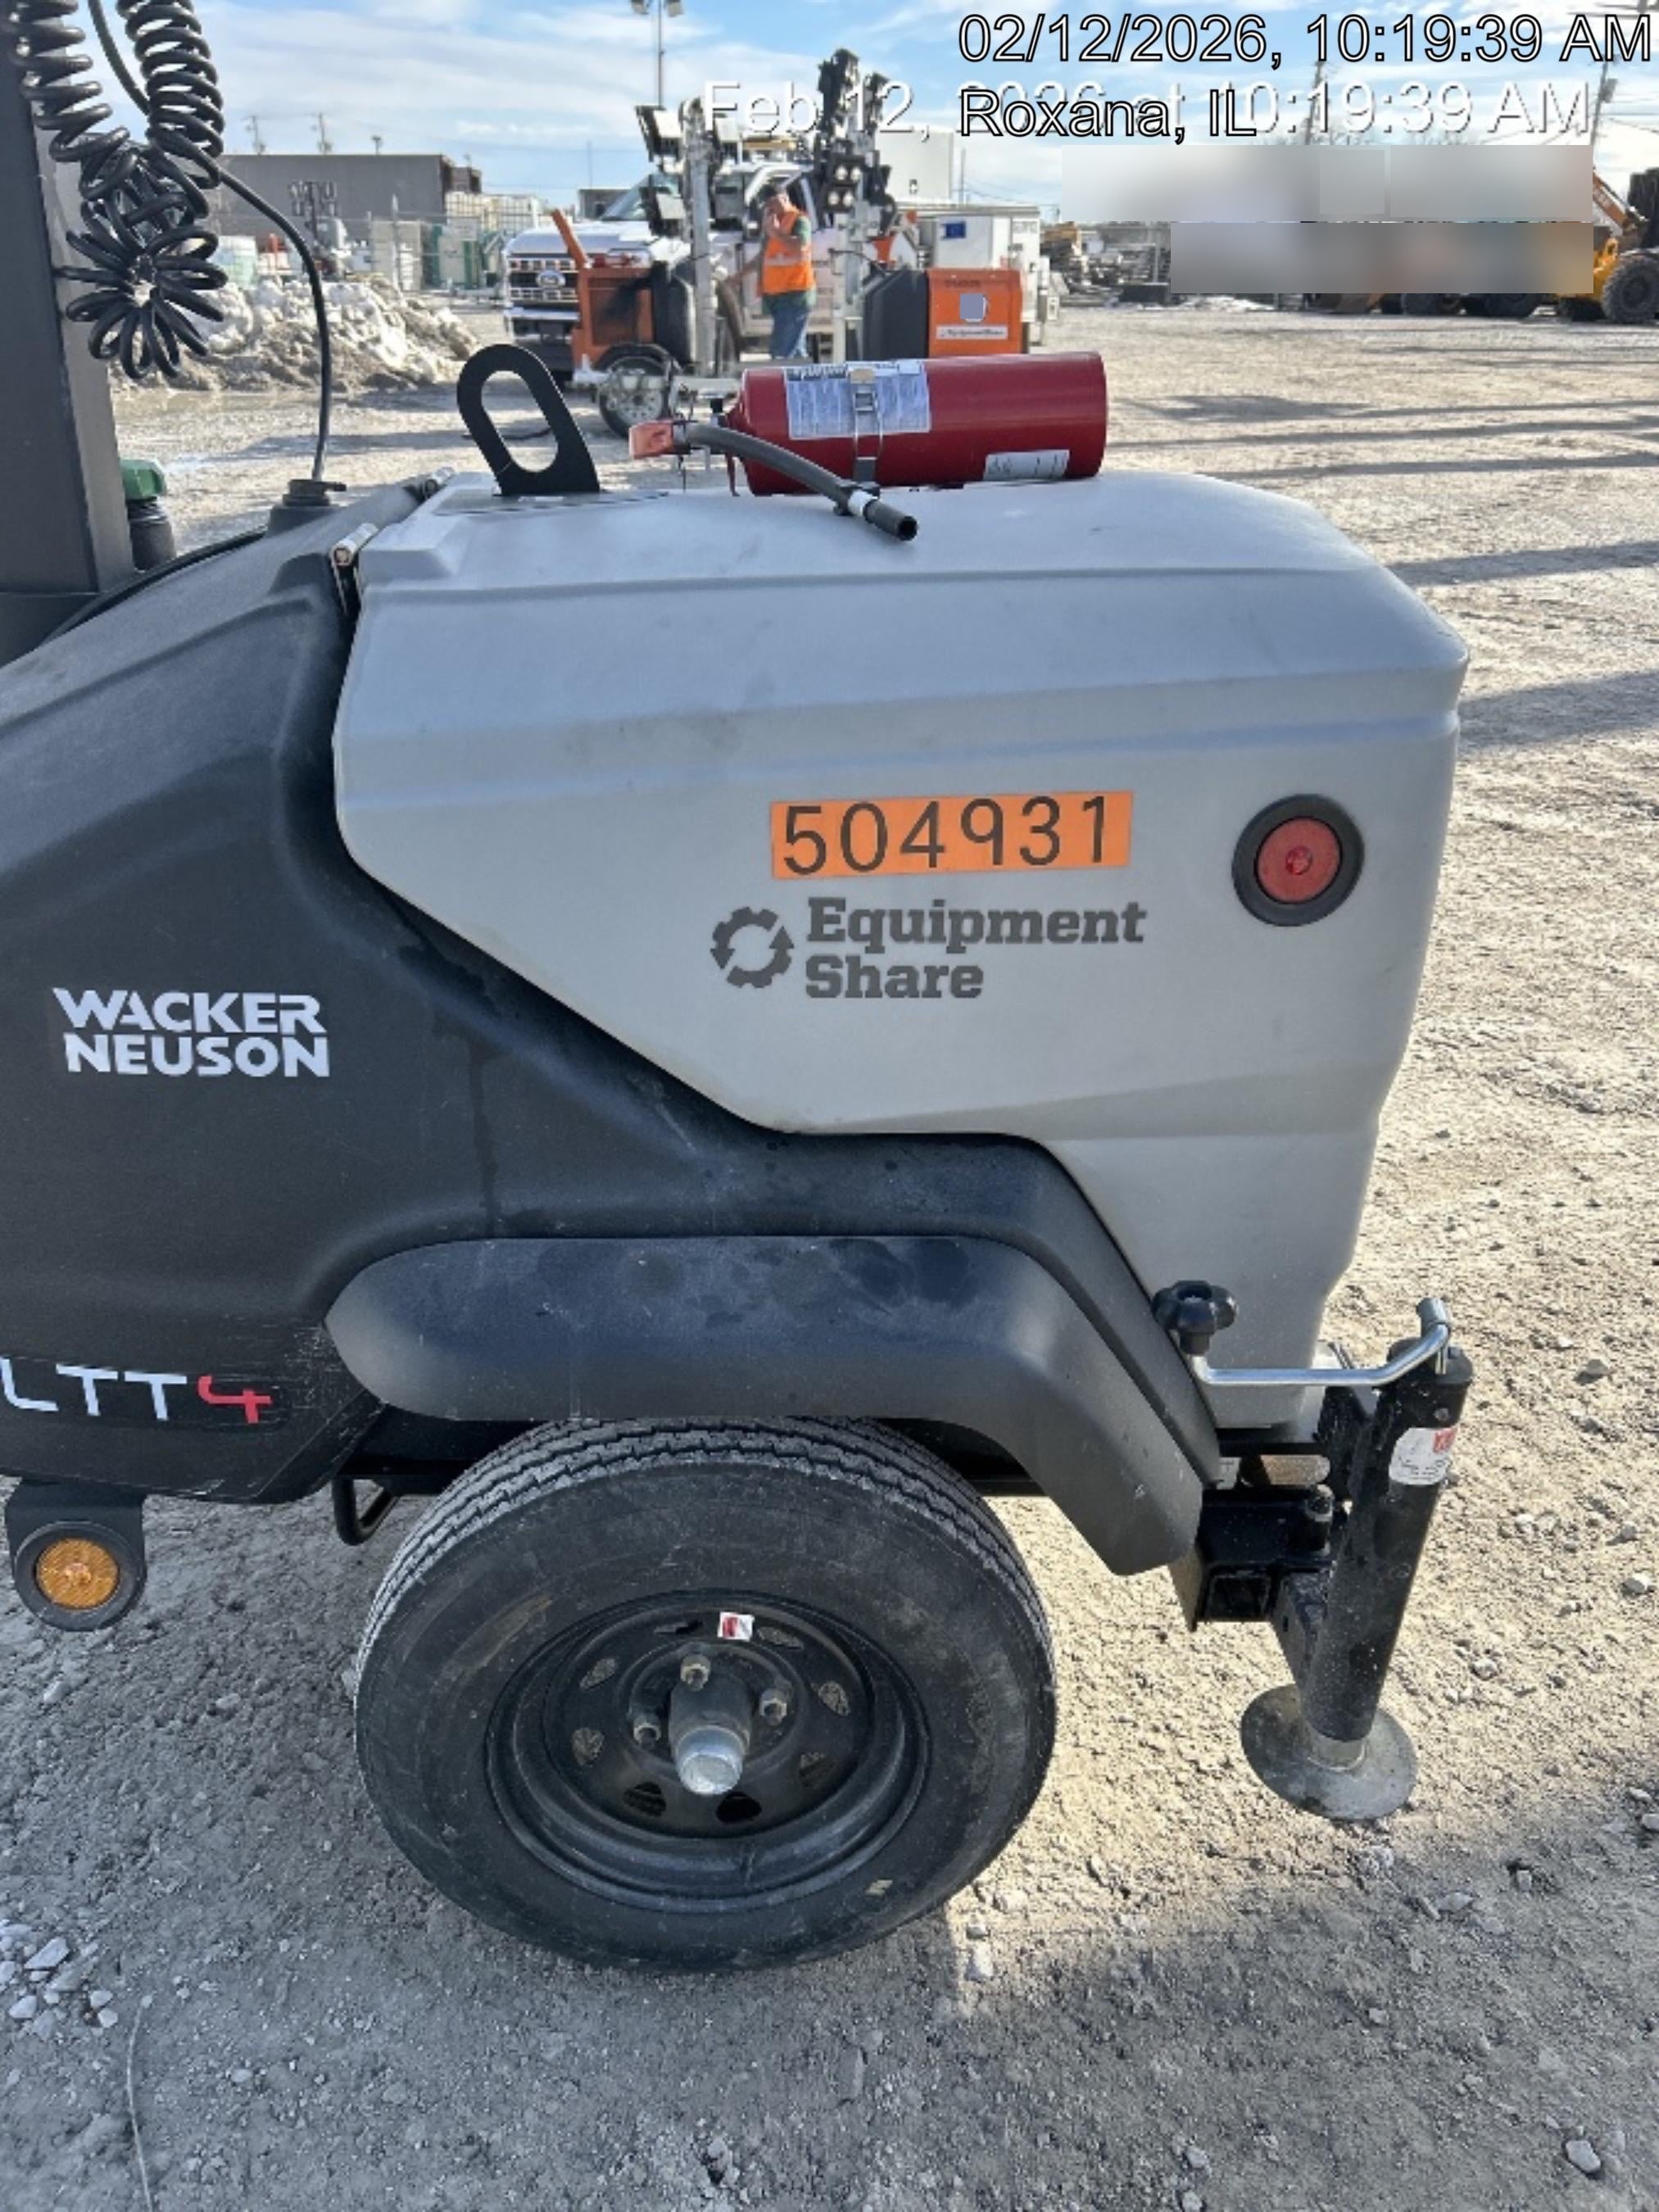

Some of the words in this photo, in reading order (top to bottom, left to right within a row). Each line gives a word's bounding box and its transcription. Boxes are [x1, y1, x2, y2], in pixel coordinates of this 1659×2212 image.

[782, 795, 1105, 876] 504931
[806, 896, 1147, 954] Equipment
[805, 954, 985, 999] Share
[52, 986, 327, 1035] WACKER
[62, 1031, 329, 1077] NEUSON
